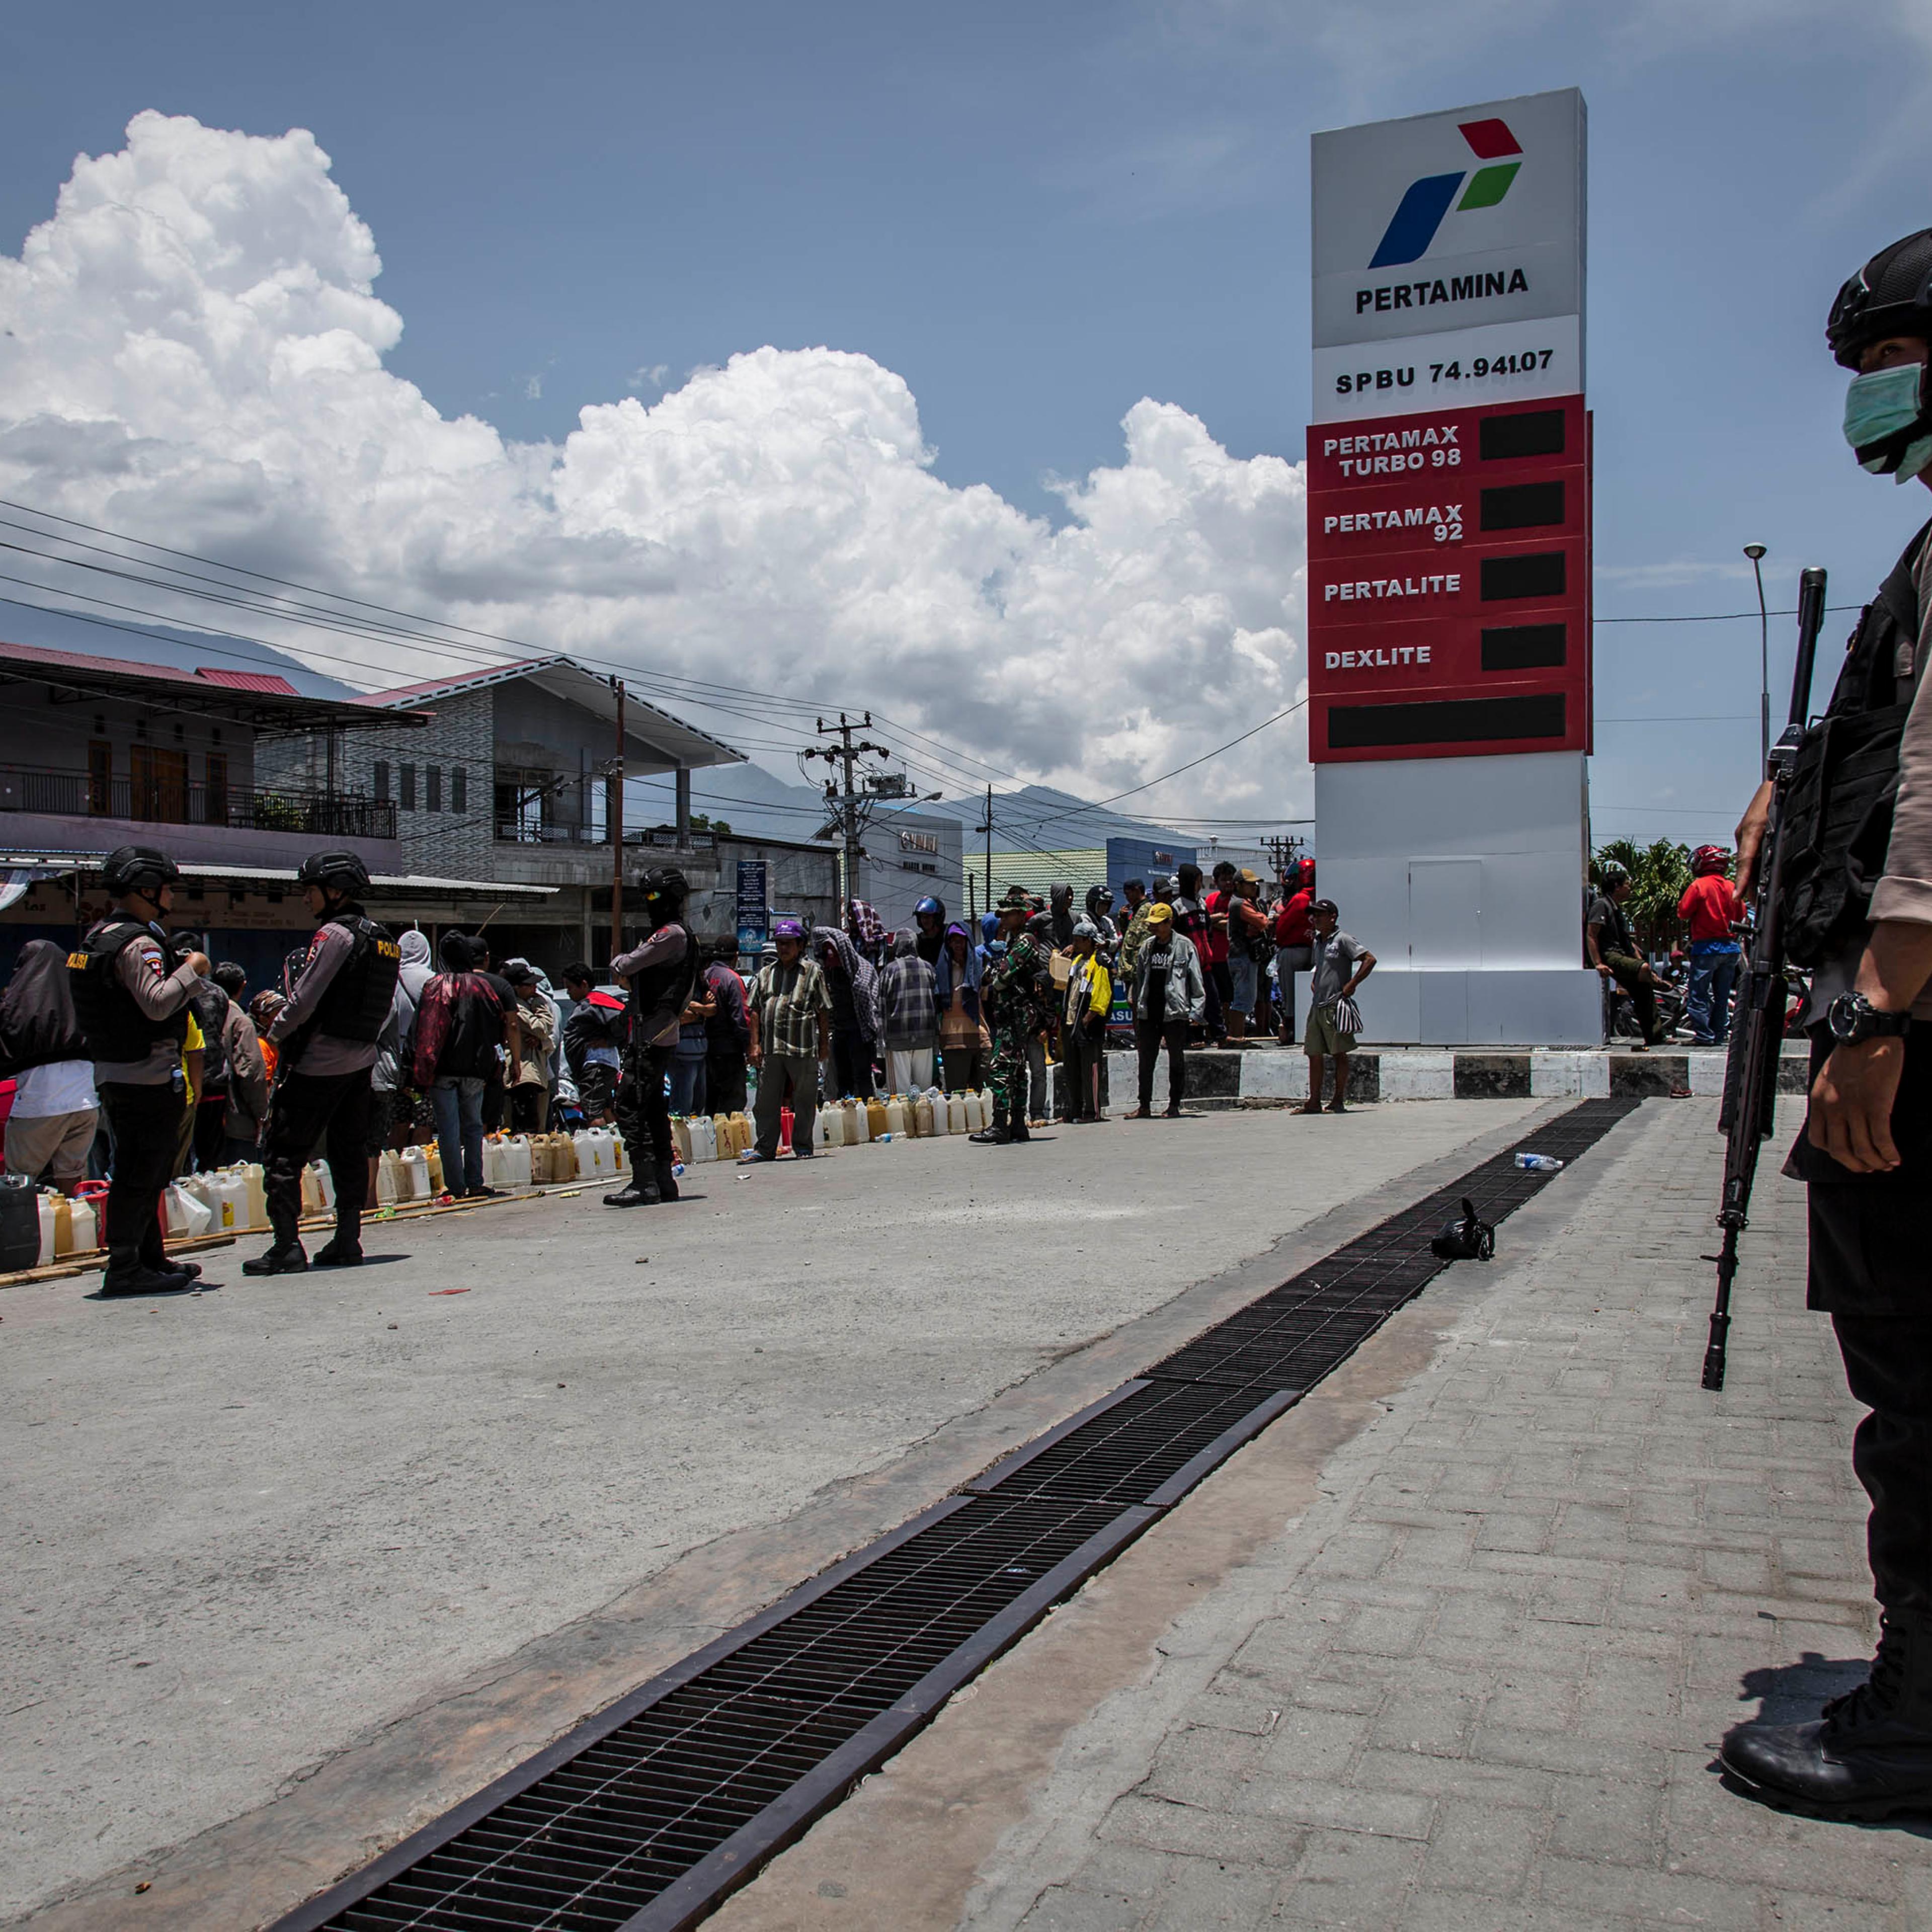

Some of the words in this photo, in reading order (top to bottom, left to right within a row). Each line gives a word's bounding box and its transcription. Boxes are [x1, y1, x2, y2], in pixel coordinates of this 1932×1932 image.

[1356, 268, 1528, 314] PERTAMINA
[1336, 367, 1414, 394] SPBU
[1429, 349, 1553, 383] 74.941.07
[1324, 426, 1459, 456] PERTAMAX
[1339, 452, 1424, 477] TURBO
[1432, 448, 1461, 467] 98
[1324, 504, 1463, 533] PERTAMAX
[1434, 523, 1463, 542] 92
[1325, 574, 1461, 601] PERTALITE
[1325, 646, 1431, 669] DEXLITE
